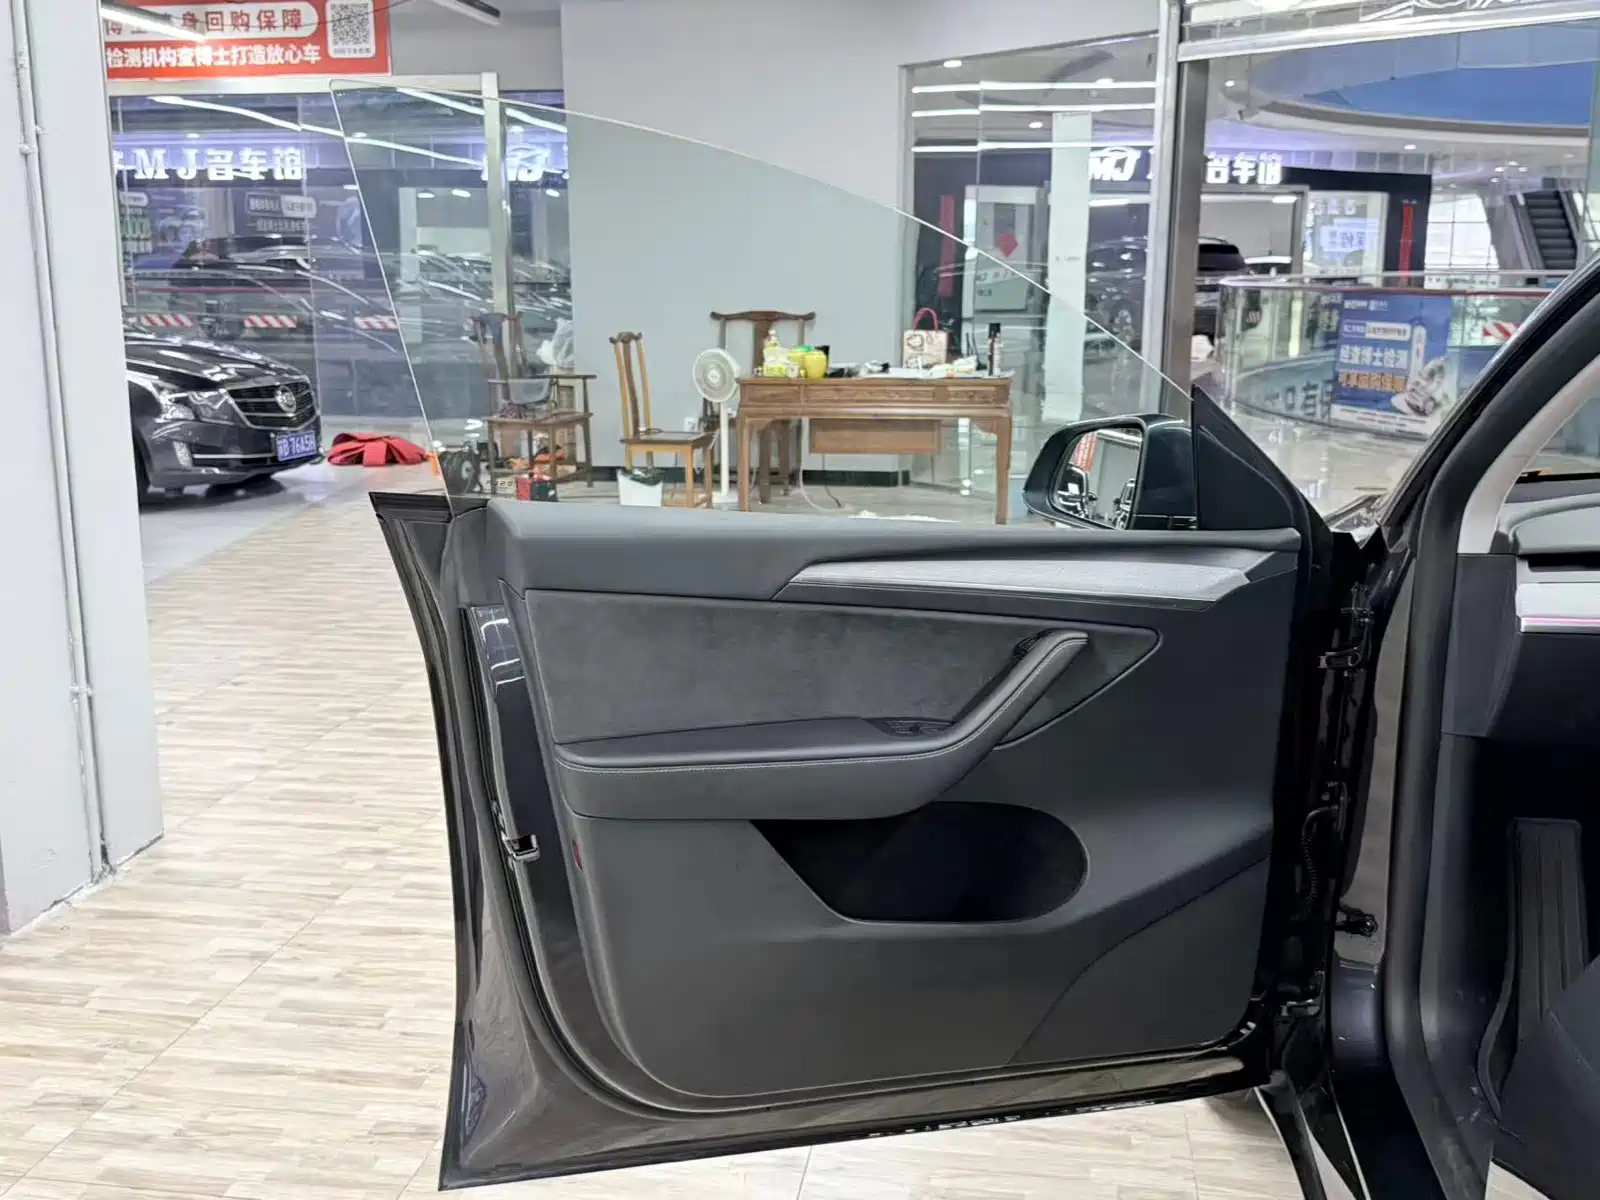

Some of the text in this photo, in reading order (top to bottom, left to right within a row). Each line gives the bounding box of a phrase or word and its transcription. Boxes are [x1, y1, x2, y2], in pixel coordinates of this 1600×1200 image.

[106, 45, 321, 69] 检测机构查博士打造放心车
